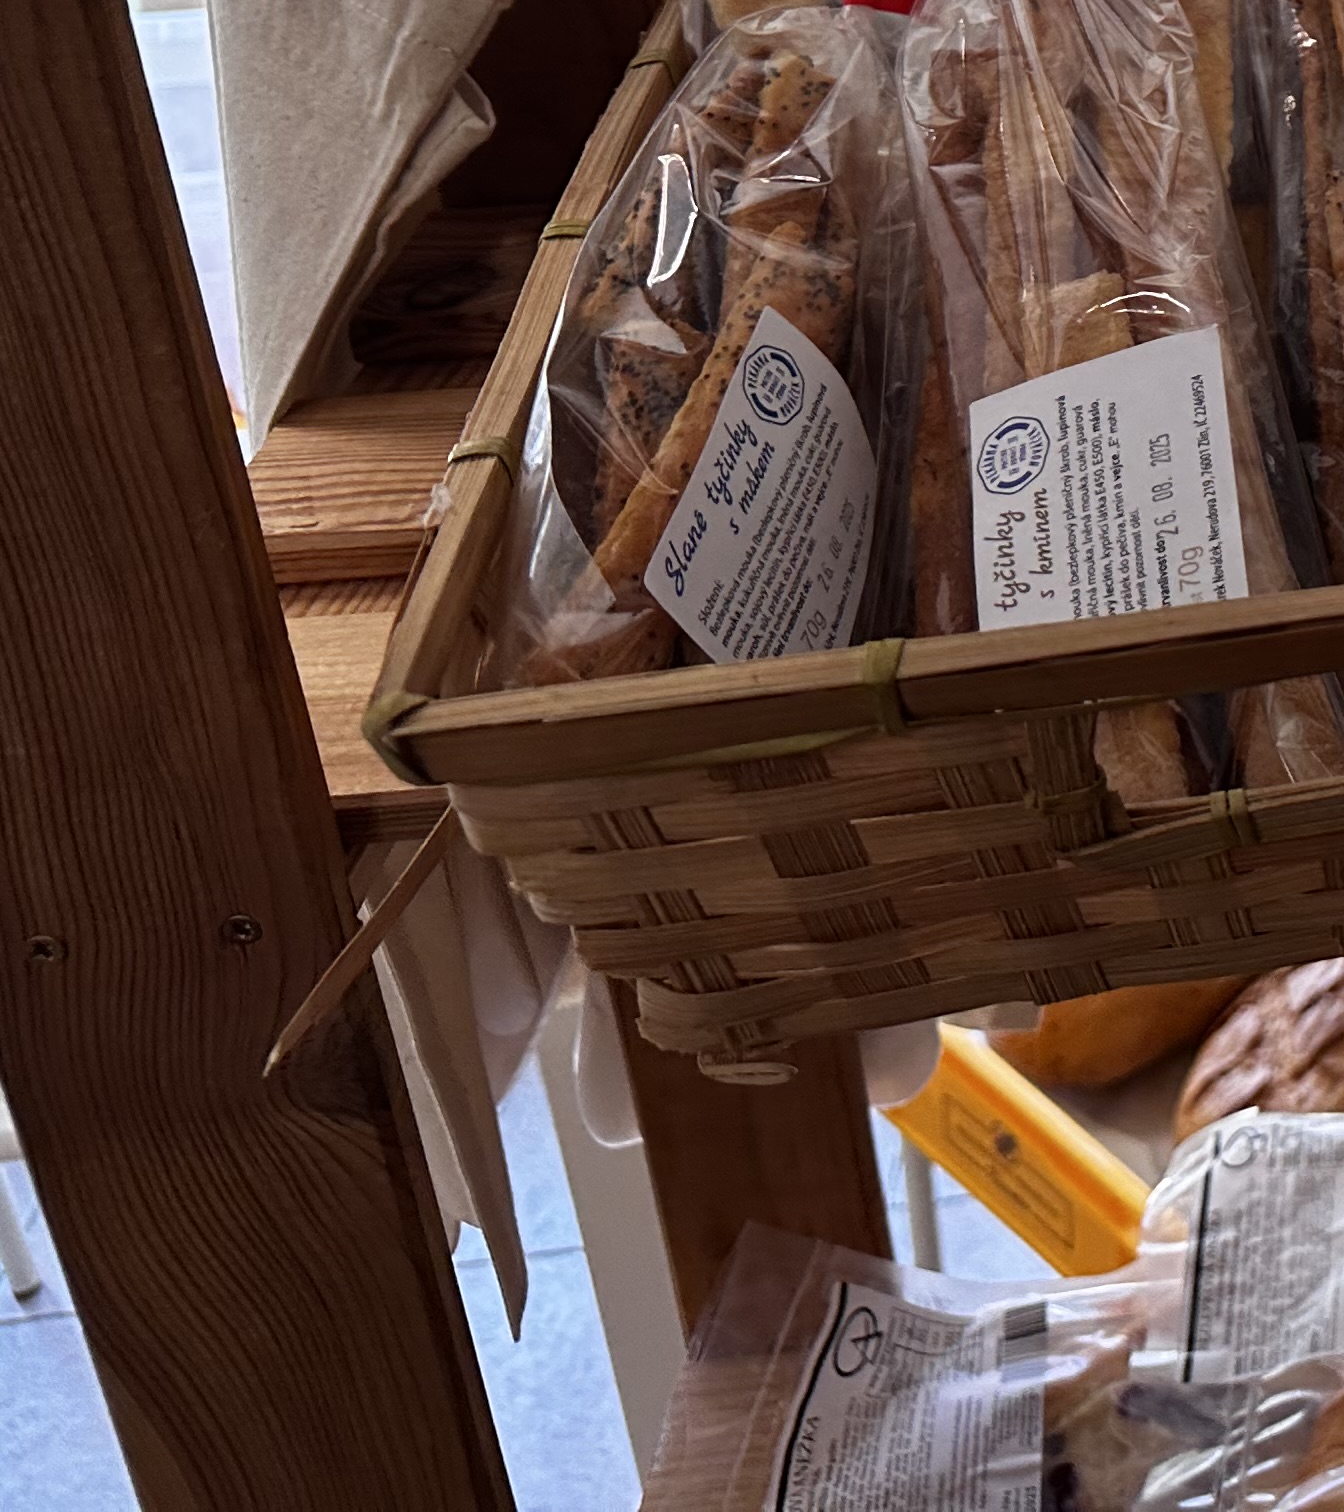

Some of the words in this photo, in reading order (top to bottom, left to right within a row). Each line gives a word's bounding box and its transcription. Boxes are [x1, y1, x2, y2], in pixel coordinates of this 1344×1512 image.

[1147, 432, 1172, 466] 2025
[663, 508, 711, 597] Slané
[706, 415, 753, 512] tyčinky
[724, 518, 743, 536] s
[737, 440, 777, 517] mákem
[980, 508, 1031, 612] tyčinky
[1022, 487, 1053, 576] kmínem
[1039, 588, 1054, 599] s
[1175, 544, 1207, 592] 70g
[800, 610, 829, 651] 70g
